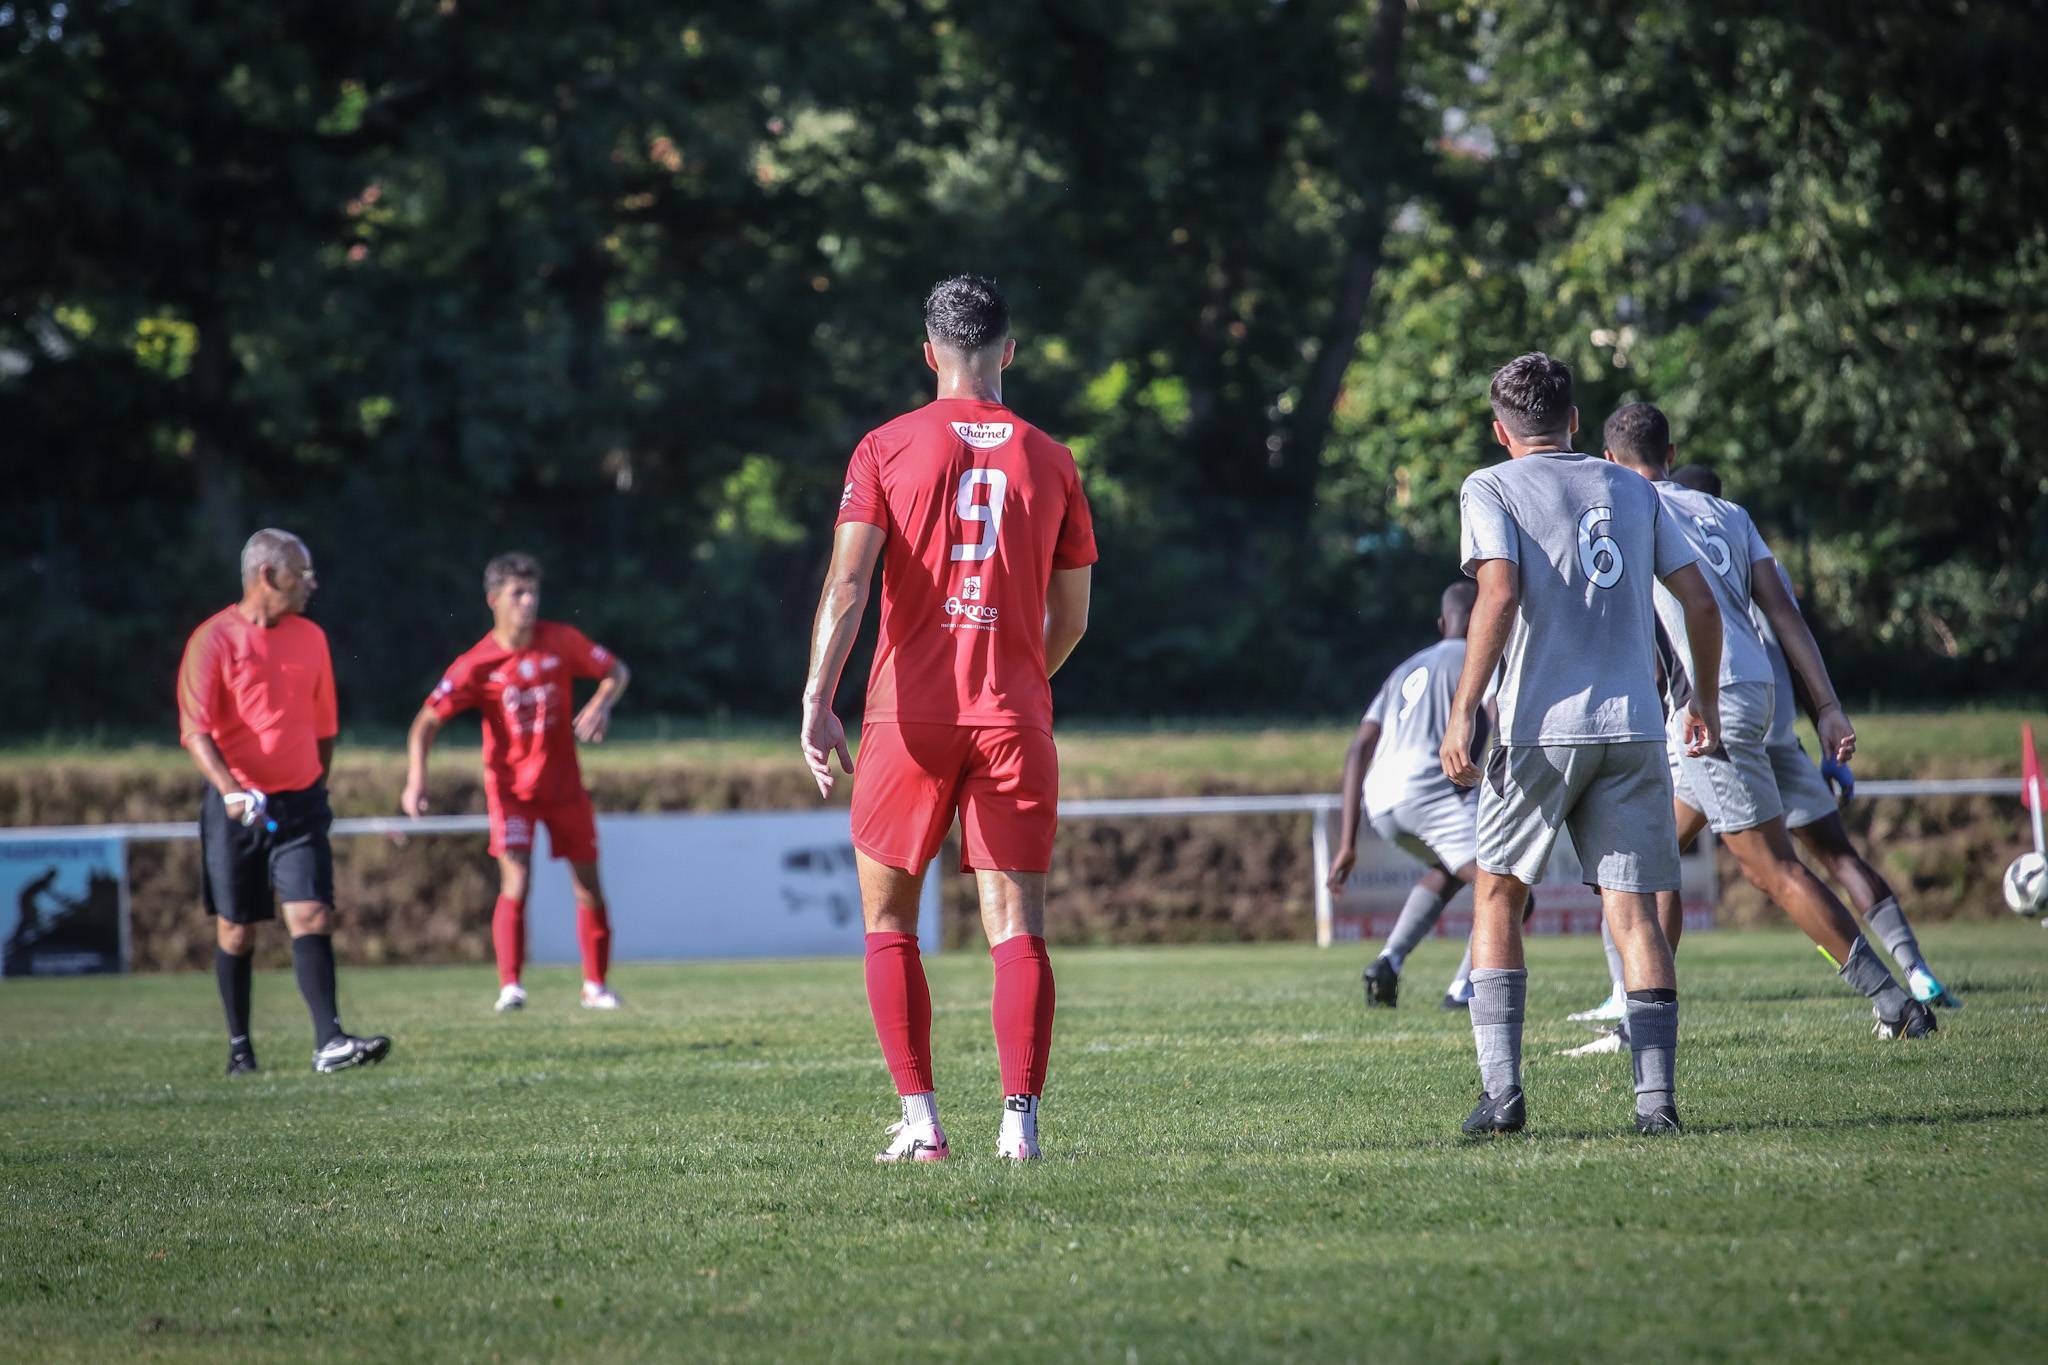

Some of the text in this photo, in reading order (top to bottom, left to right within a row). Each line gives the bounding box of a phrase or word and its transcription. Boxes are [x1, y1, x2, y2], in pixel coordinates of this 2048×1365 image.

[958, 425, 1007, 439] Charnel
[951, 468, 1007, 561] 9
[1692, 514, 1732, 577] 5
[1577, 506, 1624, 590] 6
[1398, 665, 1430, 721] 9
